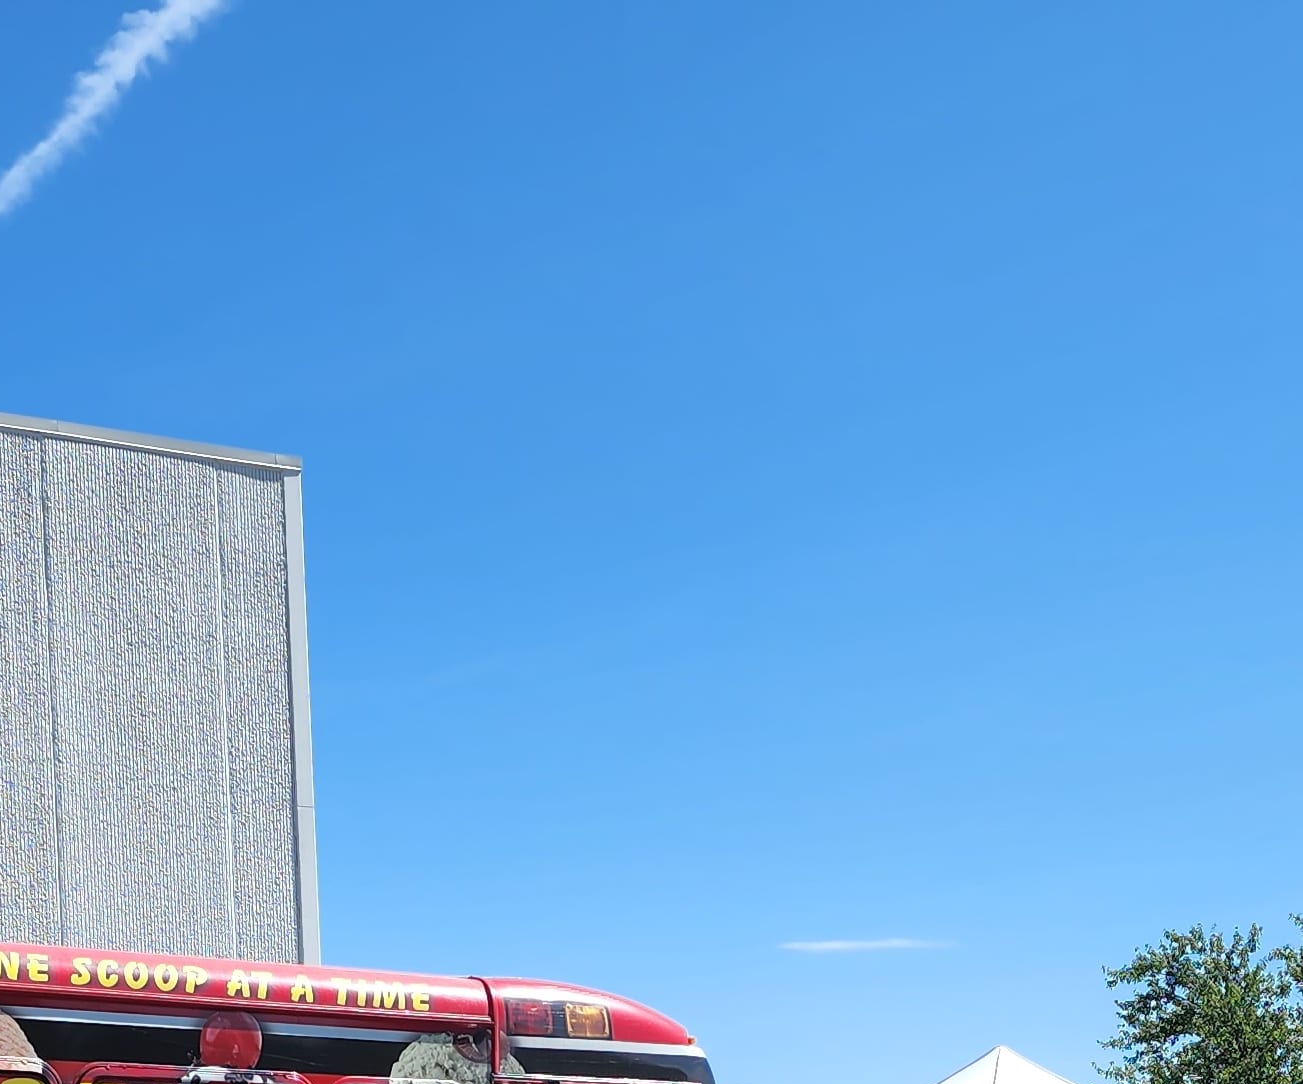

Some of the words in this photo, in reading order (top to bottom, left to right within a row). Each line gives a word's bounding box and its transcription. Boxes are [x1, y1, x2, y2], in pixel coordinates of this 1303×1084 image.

[69, 956, 209, 994] SCOOP
[226, 968, 273, 1000] AT
[290, 974, 315, 1004] A
[331, 977, 431, 1012] TIME
